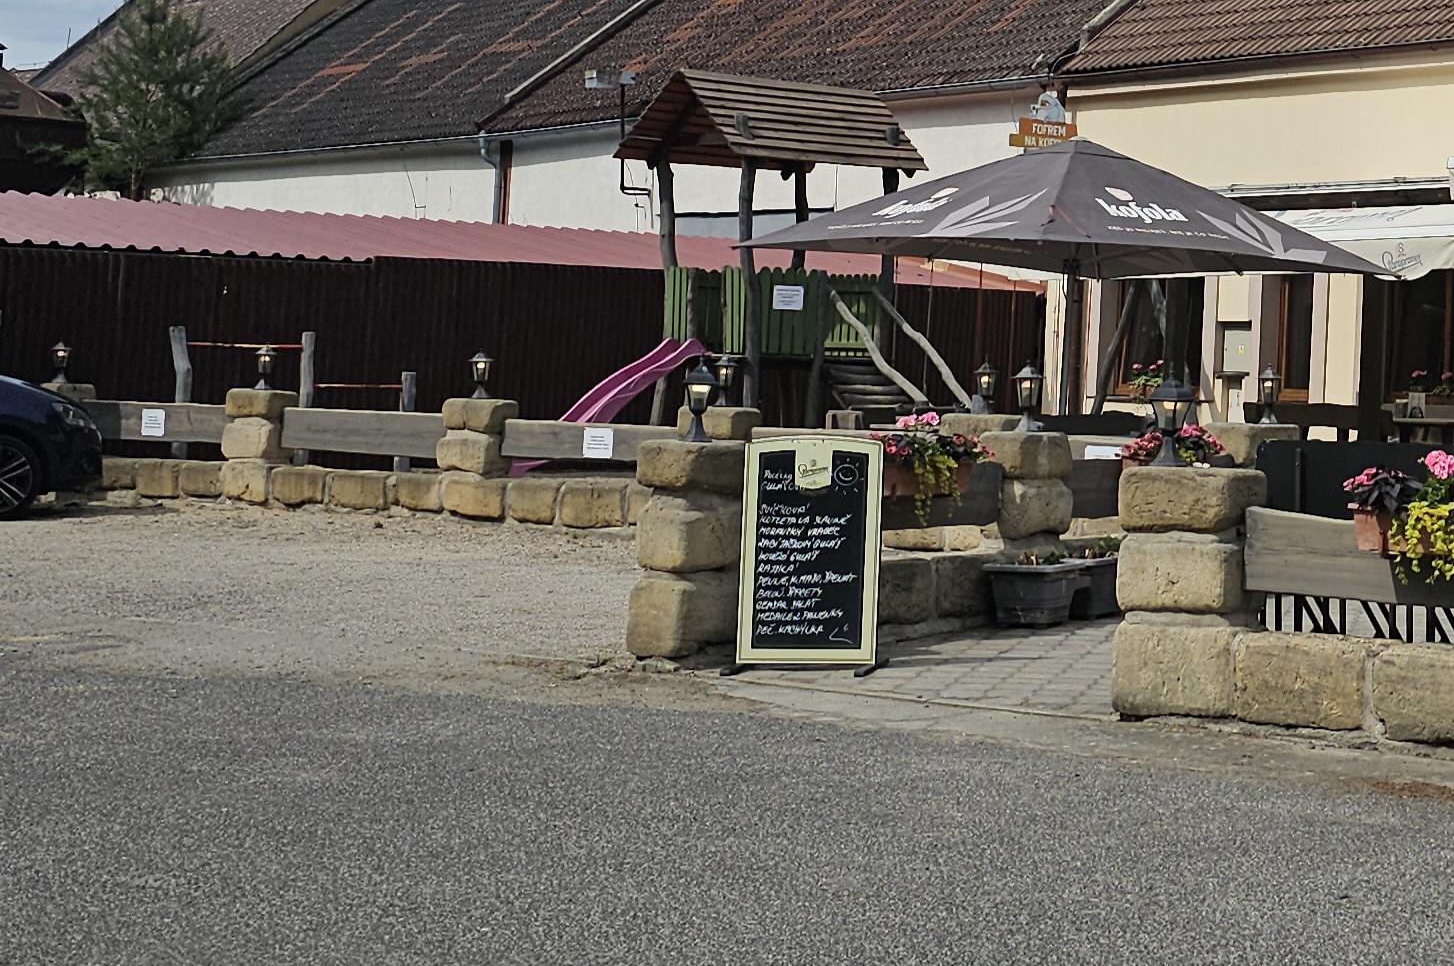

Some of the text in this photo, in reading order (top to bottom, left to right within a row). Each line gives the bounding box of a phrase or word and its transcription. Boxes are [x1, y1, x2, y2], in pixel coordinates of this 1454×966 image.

[1032, 123, 1066, 137] FOFREM
[1024, 135, 1037, 147] NA
[1095, 197, 1189, 224] kofola
